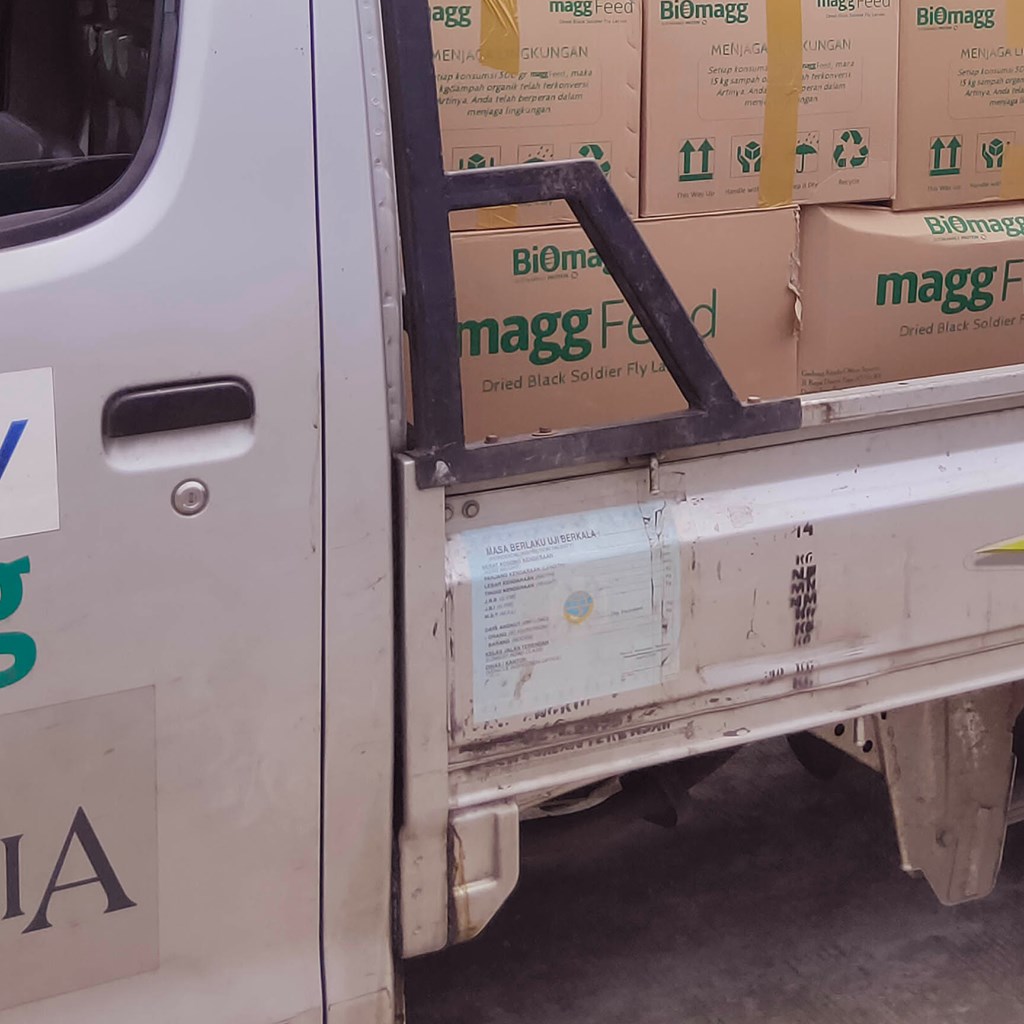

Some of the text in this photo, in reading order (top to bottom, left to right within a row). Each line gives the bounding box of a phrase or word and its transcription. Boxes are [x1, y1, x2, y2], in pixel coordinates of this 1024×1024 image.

[521, 46, 588, 60] GKUNGAN
[960, 46, 1012, 60] MENJAGA
[471, 95, 493, 104] Anda
[495, 94, 516, 103] telah
[518, 93, 556, 103] berperan
[558, 92, 583, 100] dalam
[466, 107, 503, 118] menjaga
[900, 323, 934, 337] Dried
[937, 320, 969, 334] Black
[973, 315, 1016, 330] Soldier
[482, 376, 523, 393] Dried
[527, 371, 567, 388] Black
[570, 365, 622, 384] Soldier
[627, 361, 648, 378] Fly
[486, 529, 597, 556] MASA BERLAKU UJI BERKALA
